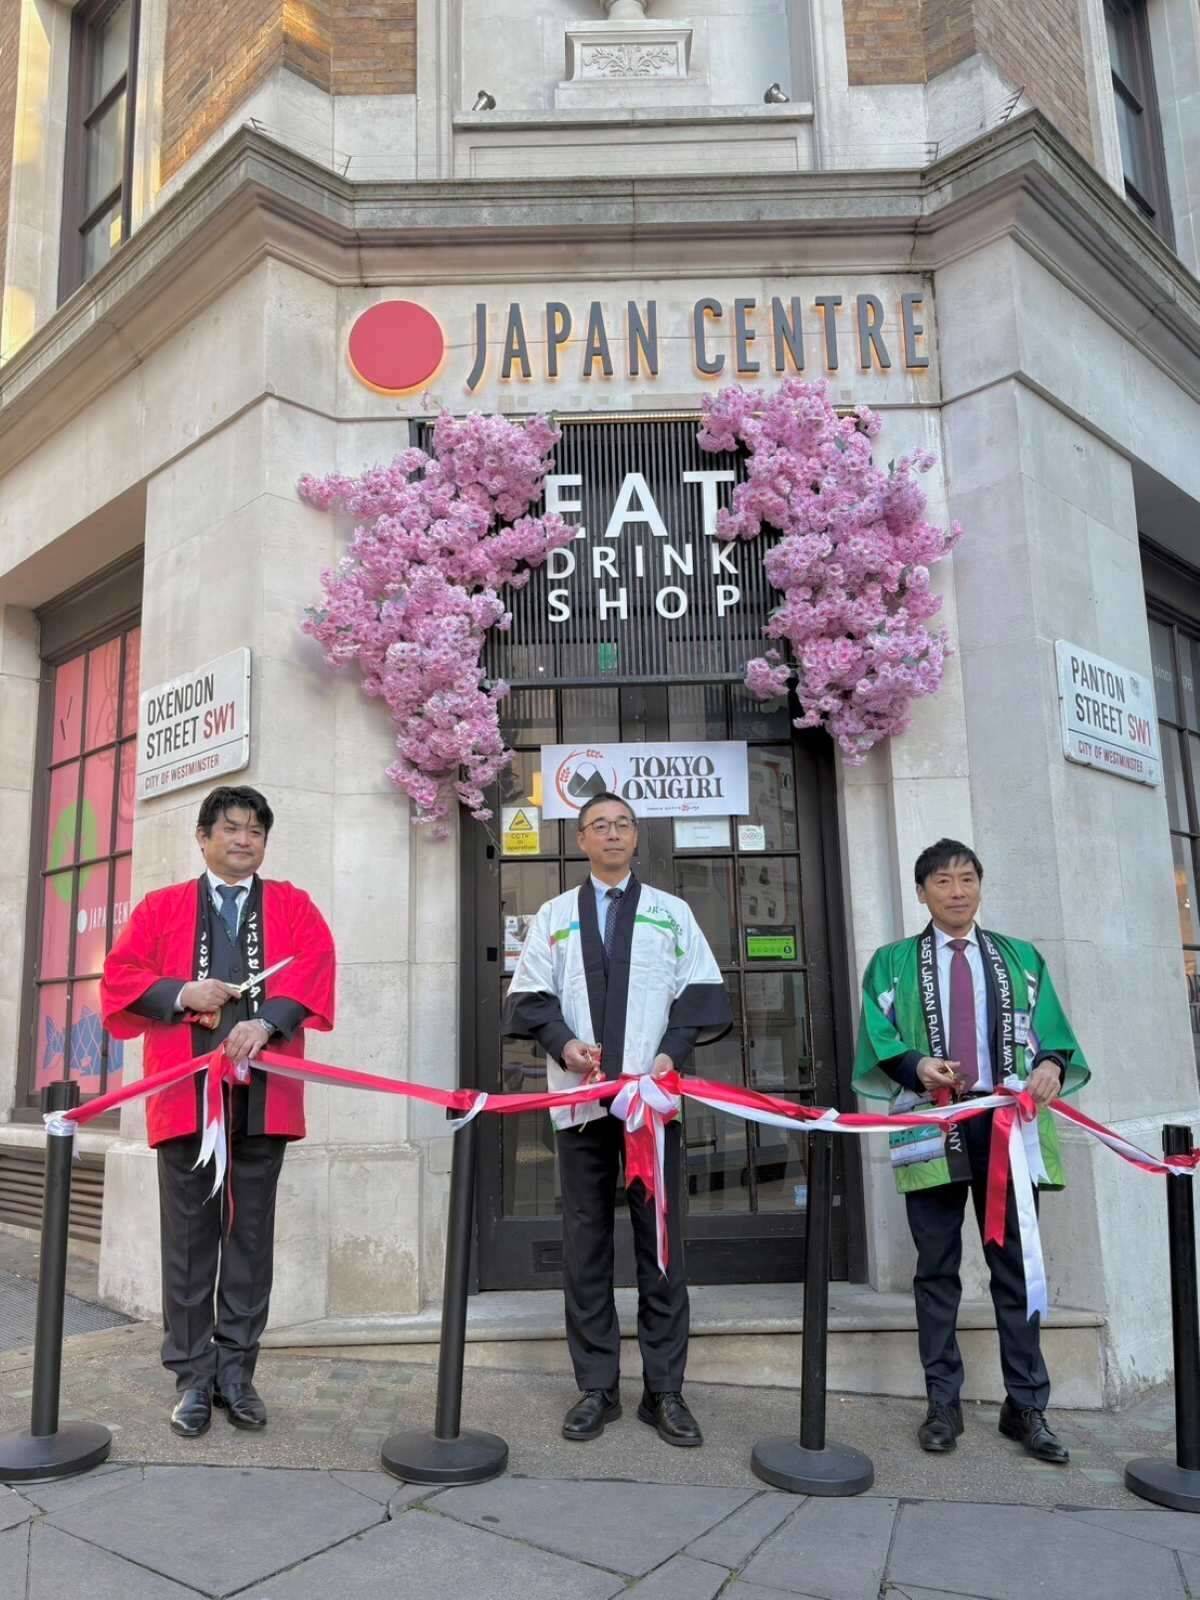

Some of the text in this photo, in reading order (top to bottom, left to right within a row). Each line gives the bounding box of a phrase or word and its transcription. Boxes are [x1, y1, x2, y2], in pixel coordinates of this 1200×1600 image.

[466, 293, 931, 391] JAPAN CENTRE
[545, 470, 735, 538] EAT
[547, 542, 738, 579] DRINK
[548, 585, 740, 622] SHOP
[147, 673, 214, 726] OXENDON
[1071, 656, 1126, 703] PANTON
[146, 701, 235, 760] STREET SW1
[1075, 693, 1152, 746] STREET SW1
[144, 754, 219, 790] CITY OF WESTMINSTER
[629, 755, 715, 777] TOKYO
[1078, 741, 1144, 773] CITY OF WESTMINSTER
[622, 777, 725, 800] ONIGIRI
[921, 936, 933, 965] EAST
[921, 966, 936, 1011] JAPAN
[993, 964, 1011, 1009] JAPAN
[1002, 1013, 1013, 1074] RAILWAY
